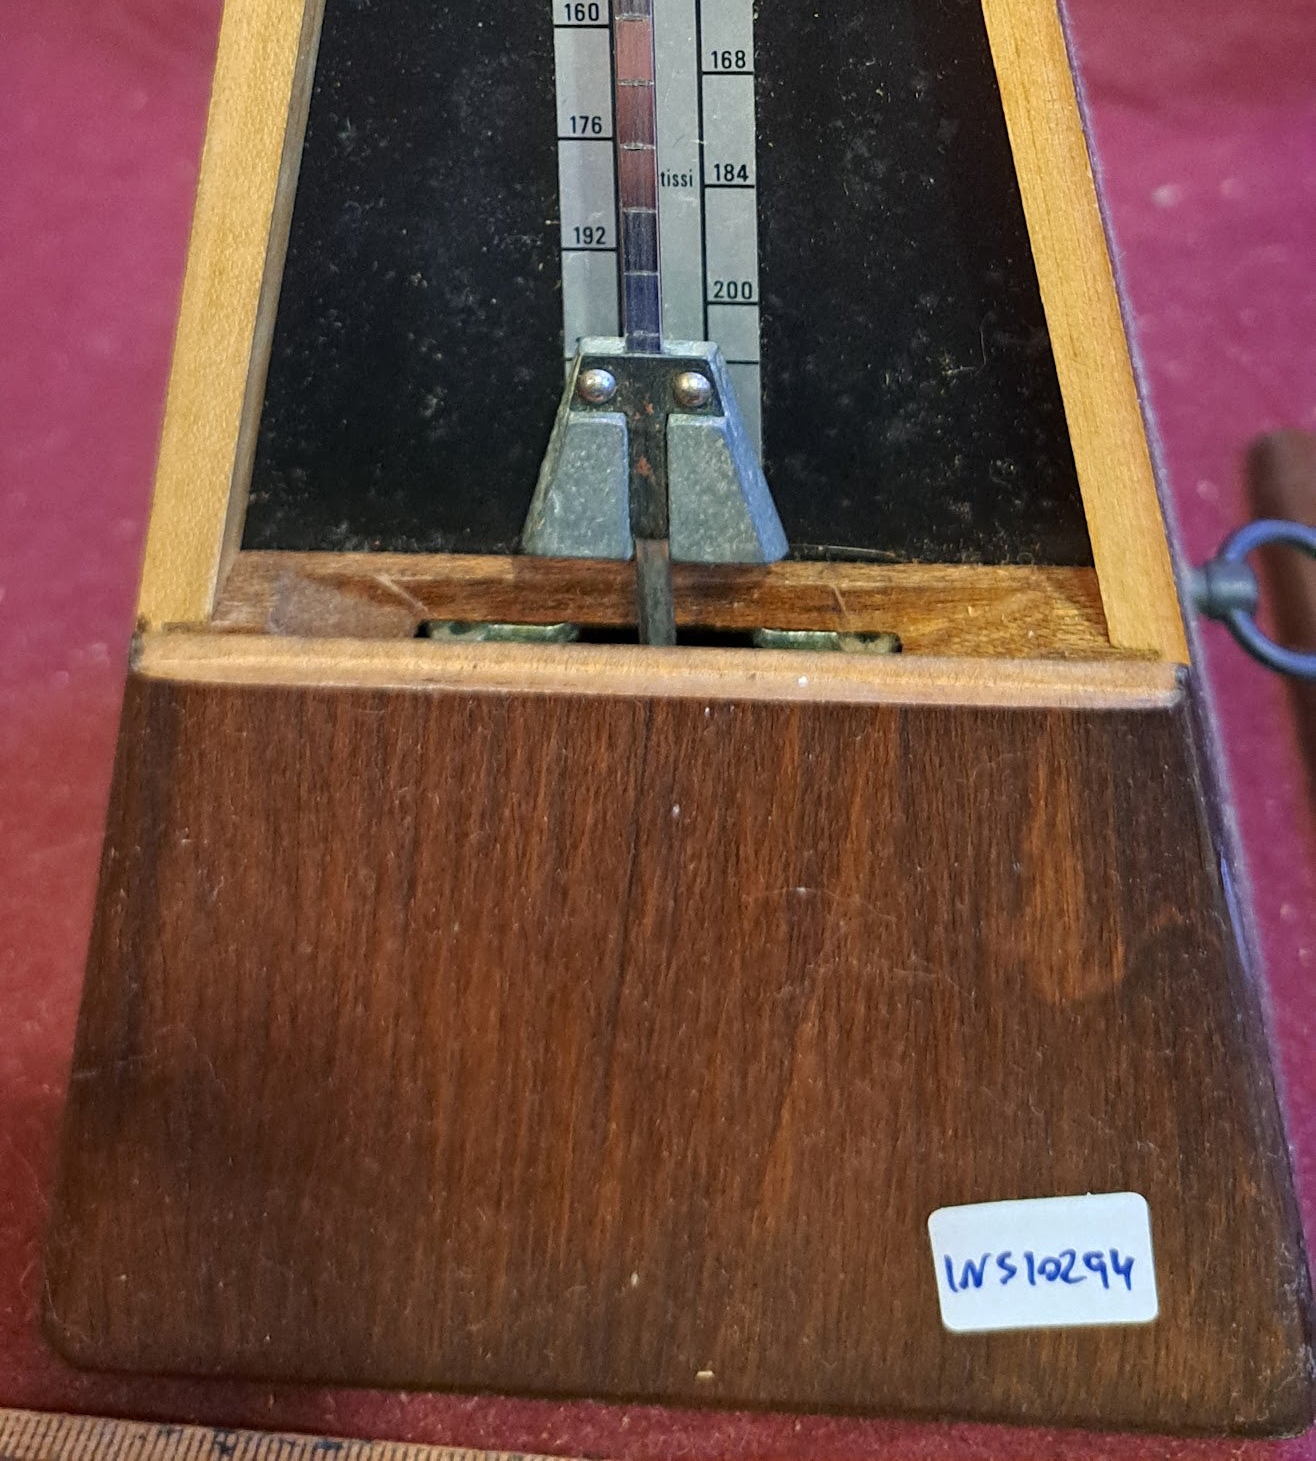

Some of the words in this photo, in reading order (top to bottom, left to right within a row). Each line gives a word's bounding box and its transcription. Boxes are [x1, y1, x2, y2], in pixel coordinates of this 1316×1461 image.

[564, 2, 600, 22] 160
[710, 50, 746, 70] 168
[569, 115, 603, 135] 176
[660, 168, 694, 188] tissi
[713, 163, 750, 183] 184
[573, 226, 607, 245] 192
[713, 280, 753, 300] 200
